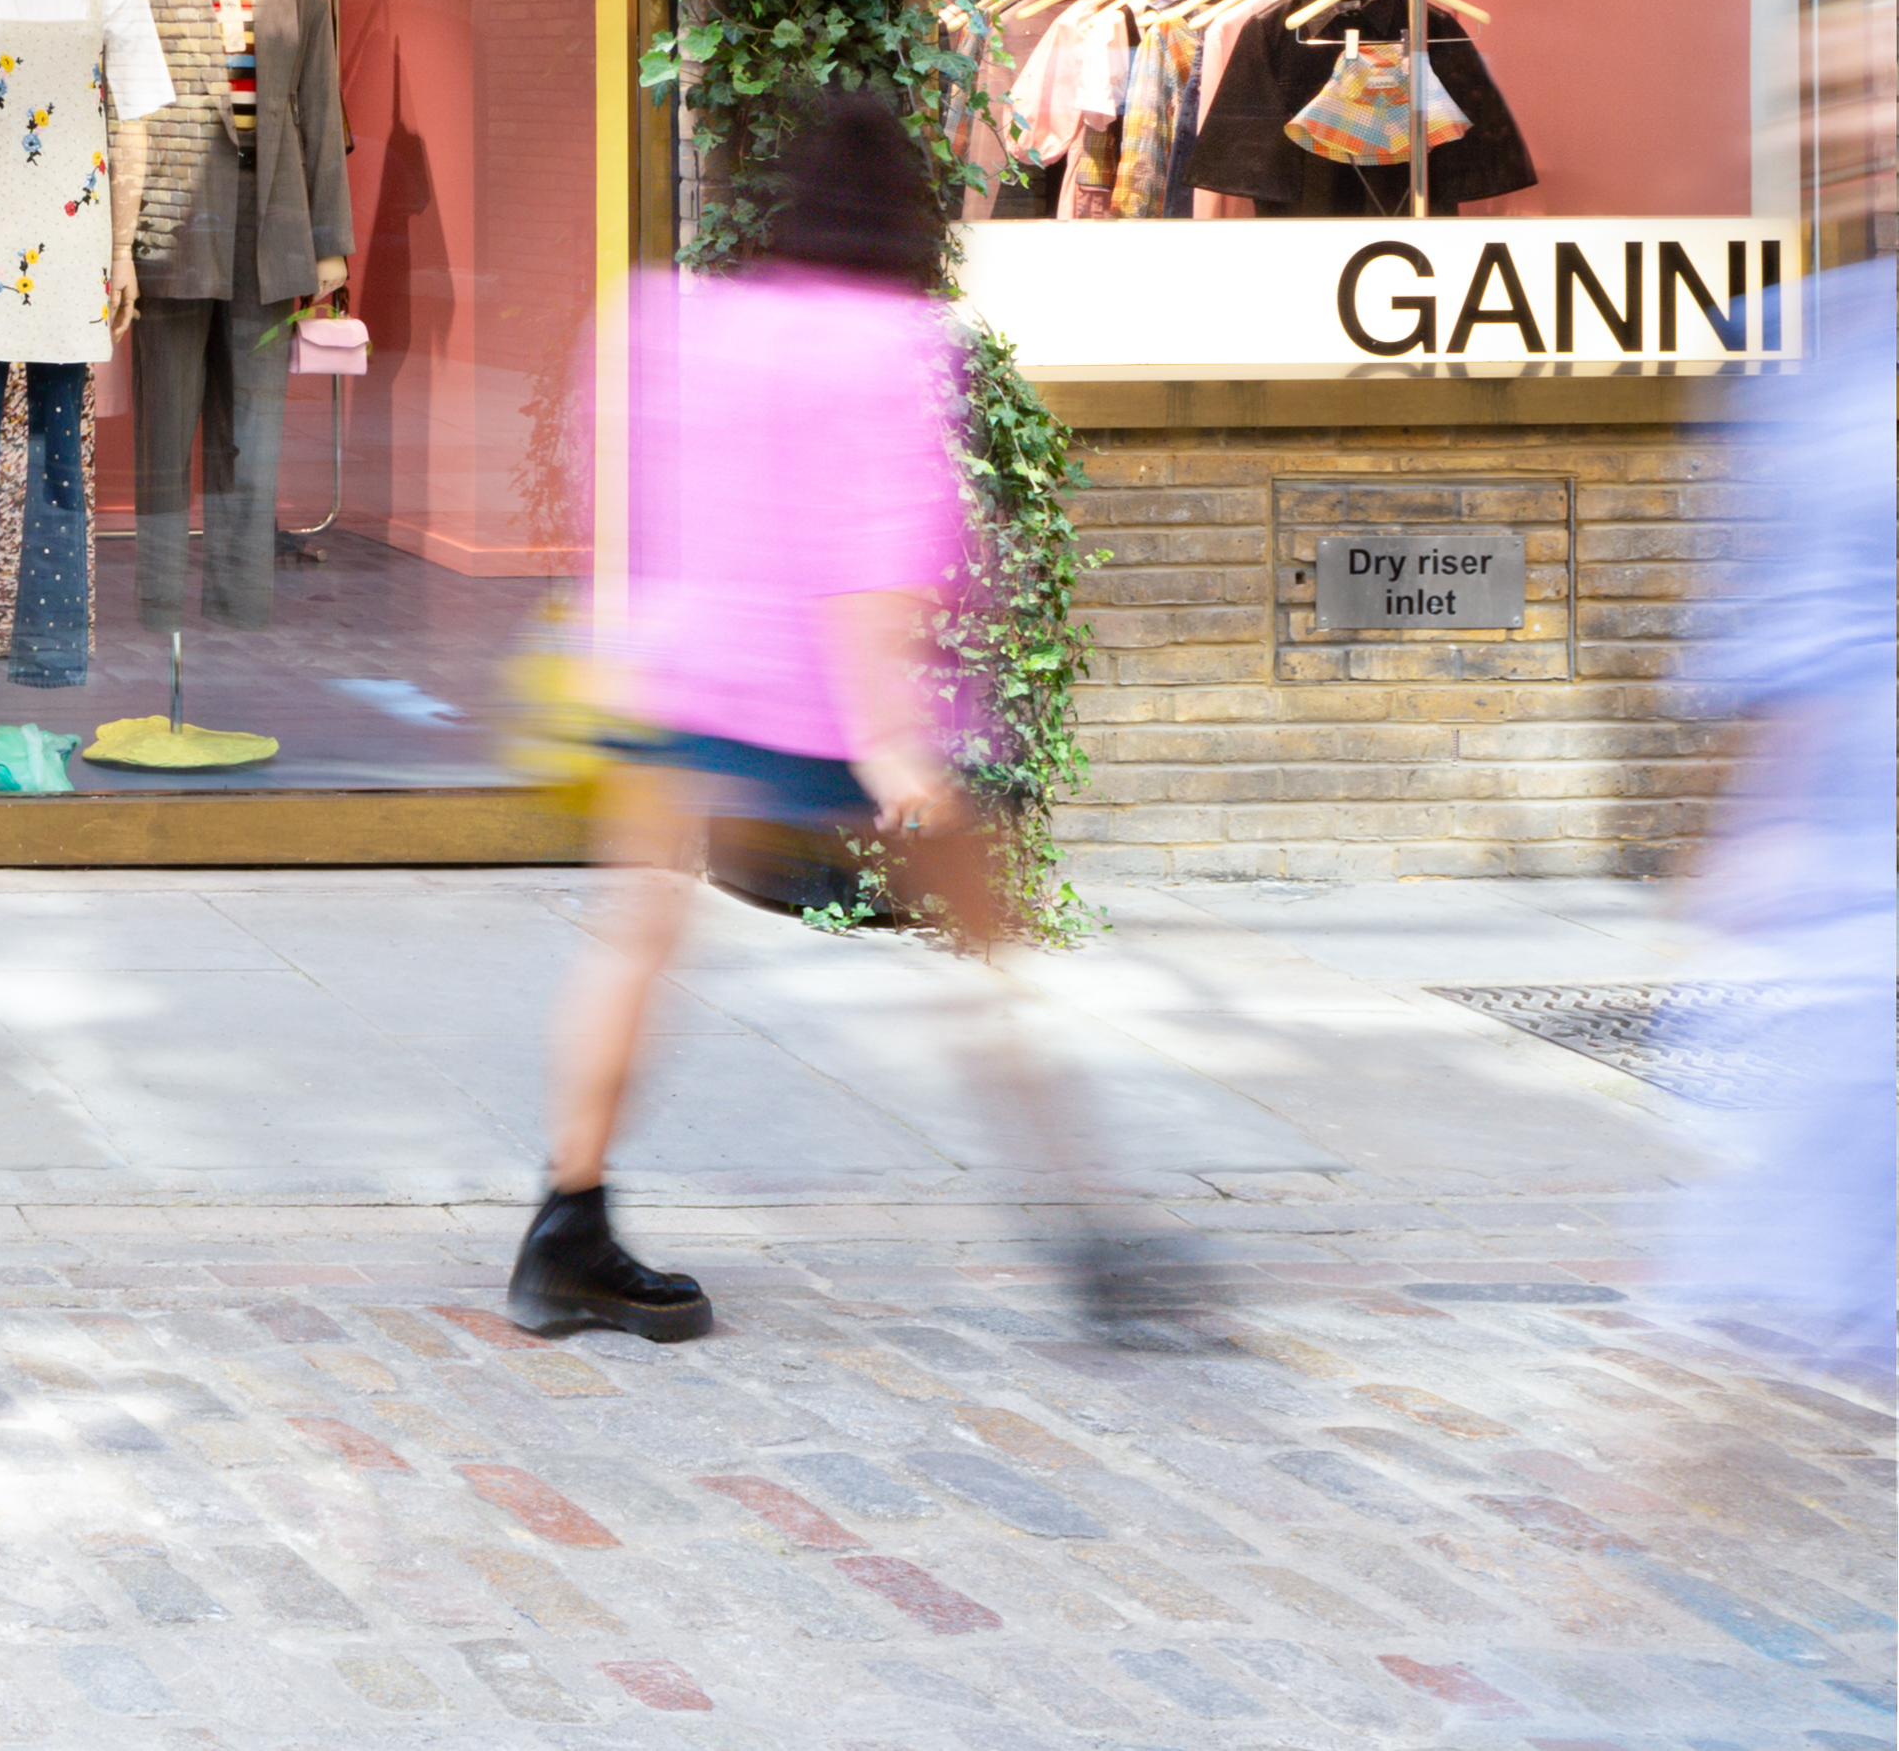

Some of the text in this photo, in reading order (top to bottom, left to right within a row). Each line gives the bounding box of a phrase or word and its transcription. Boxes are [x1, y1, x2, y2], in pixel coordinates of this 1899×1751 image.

[1336, 239, 1782, 357] GANNI
[1349, 548, 1493, 582] Dry riser
[1385, 588, 1457, 615] inlet
